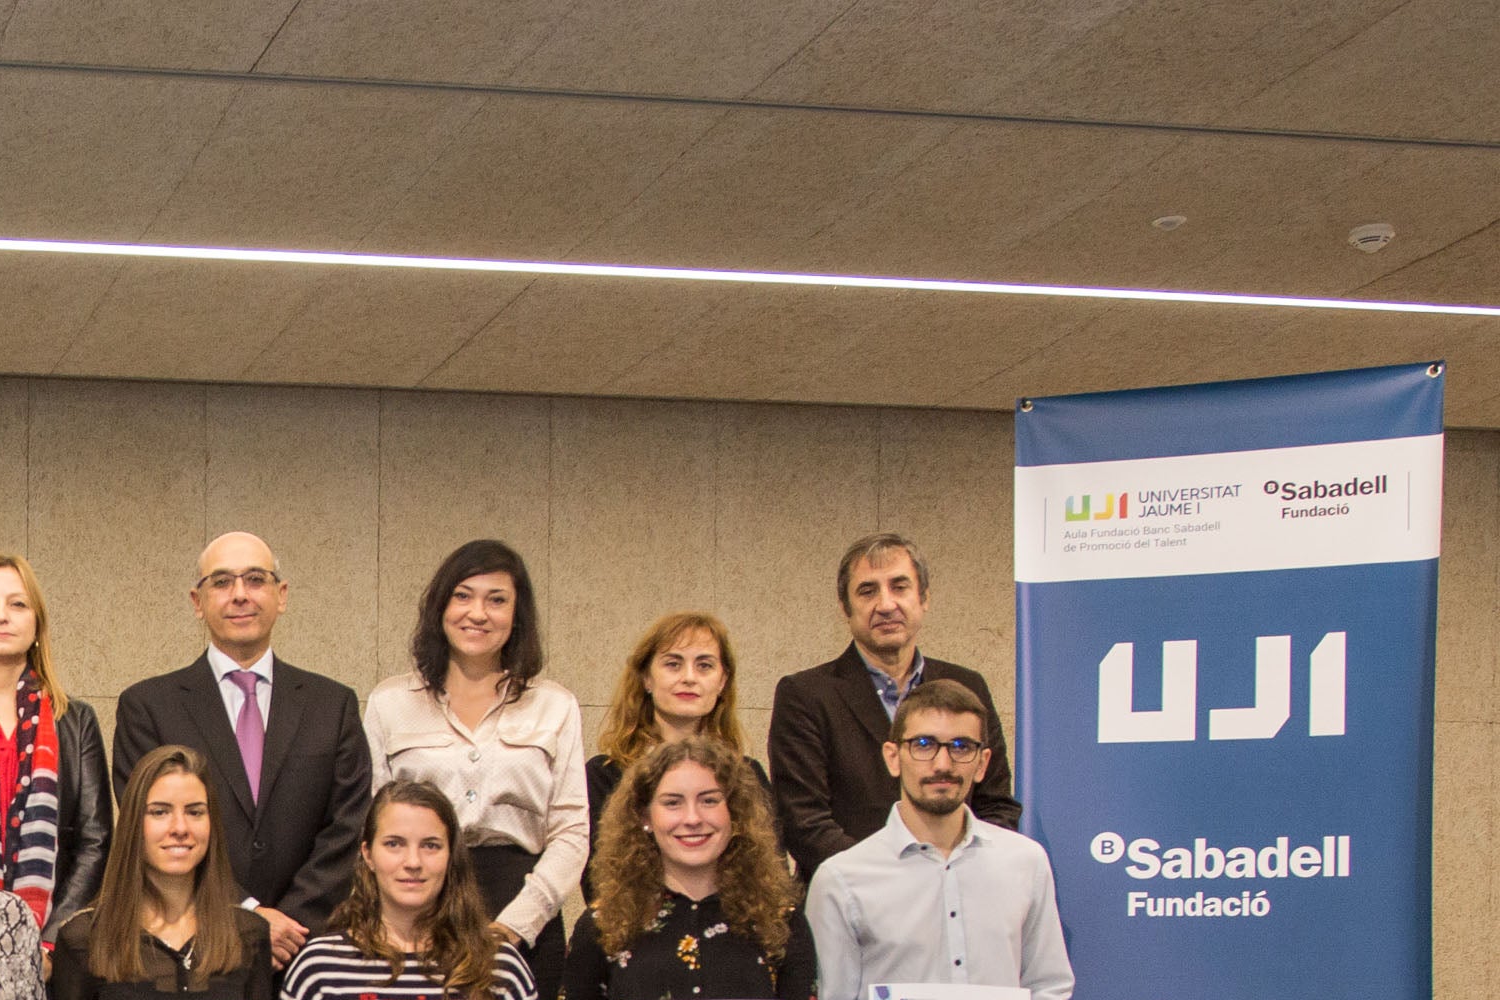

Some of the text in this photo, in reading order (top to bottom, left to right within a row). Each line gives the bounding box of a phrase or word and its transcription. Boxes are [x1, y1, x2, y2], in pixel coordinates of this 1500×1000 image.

[1138, 484, 1243, 504] UNIVERSITAT
[1281, 475, 1387, 501] Sabadell
[1138, 502, 1201, 518] JAUME I
[1282, 503, 1350, 519] Fundació
[1064, 521, 1221, 539] Aula Fundació Banc Sabadell
[1064, 537, 1187, 552] de Promoció del Talent
[1125, 835, 1351, 879] Sabadell
[1127, 890, 1271, 918] Fundació
